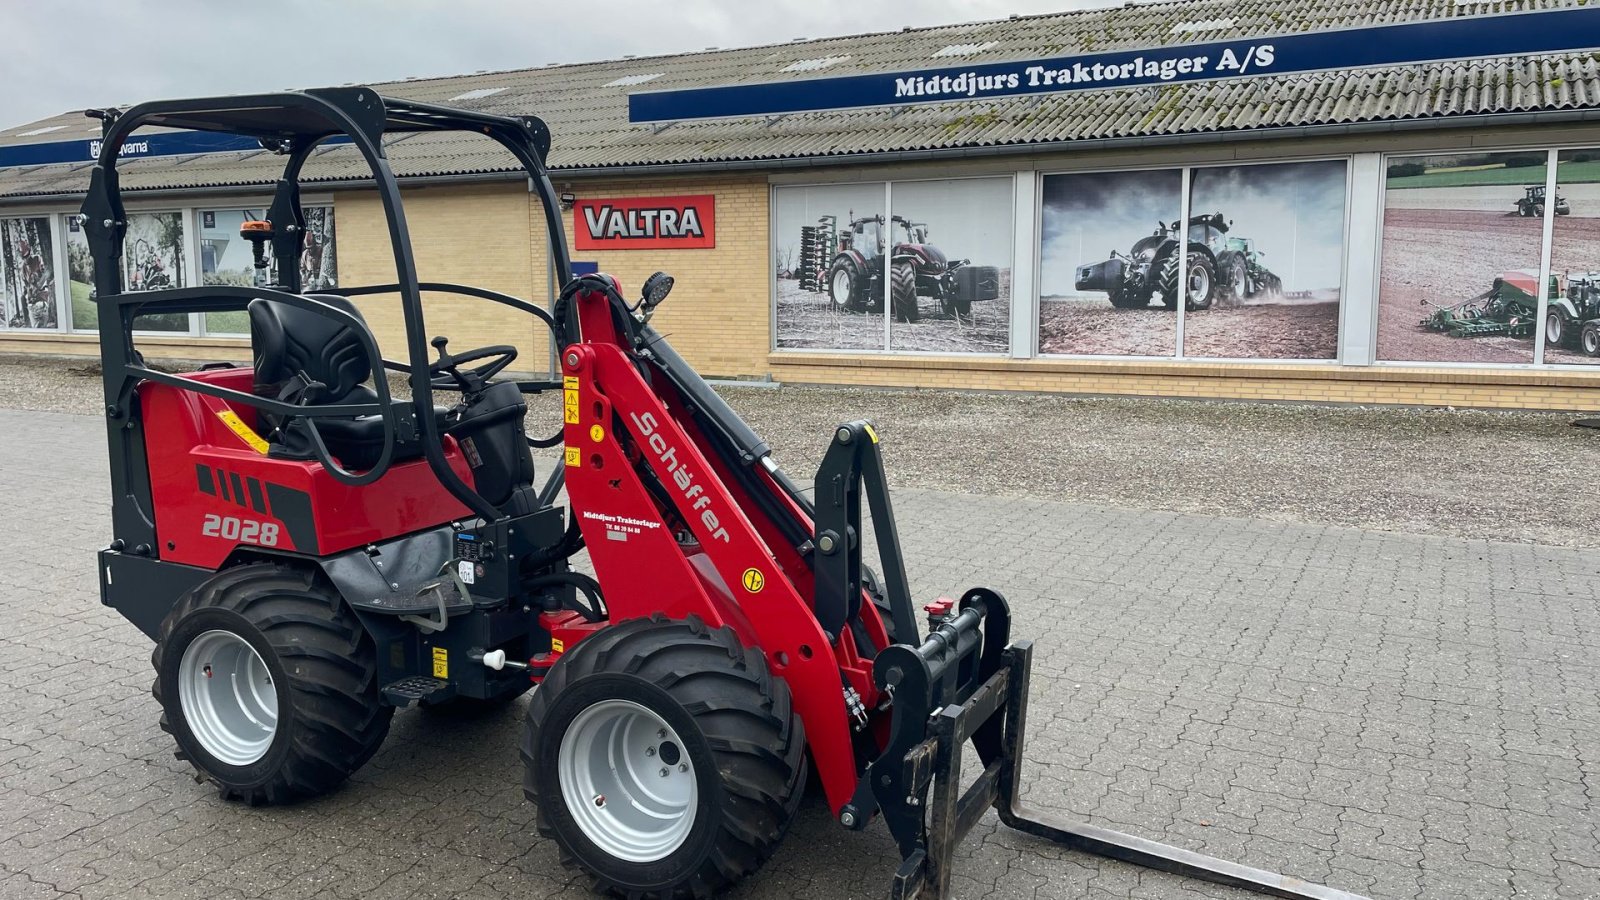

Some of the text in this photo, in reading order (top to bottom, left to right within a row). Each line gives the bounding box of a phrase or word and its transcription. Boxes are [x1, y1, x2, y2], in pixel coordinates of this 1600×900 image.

[895, 44, 1275, 98] Midtdjurs Traktorlager A/S
[582, 205, 704, 239] VALTRA
[630, 411, 730, 543] Schäffer
[202, 513, 279, 546] 2028
[583, 511, 660, 528] Midtdjurs Traktorlager
